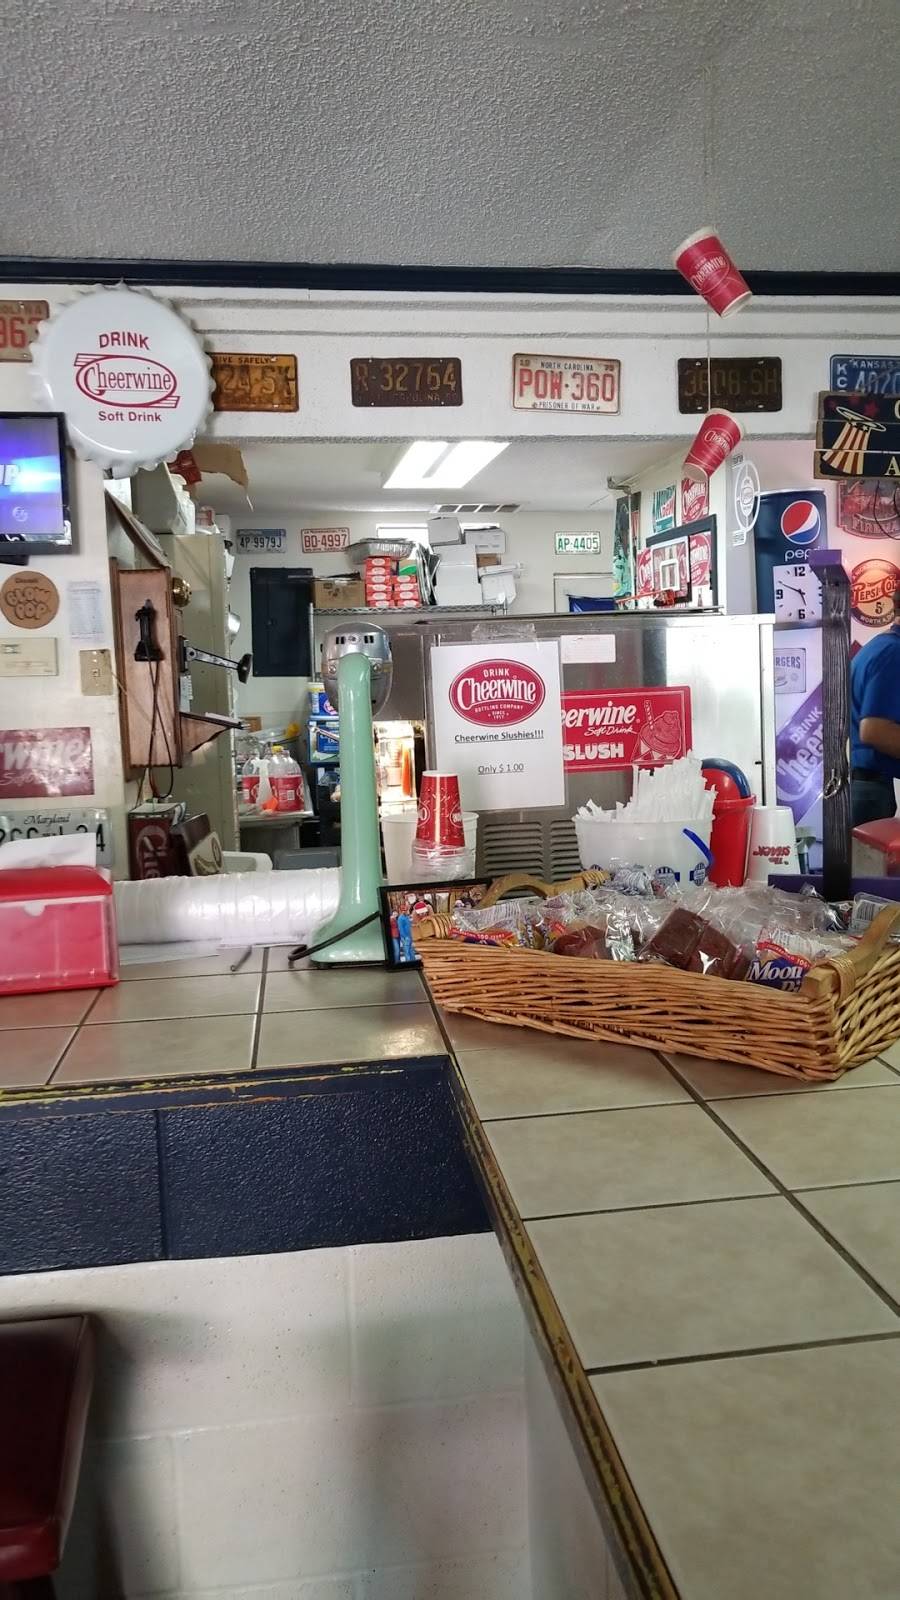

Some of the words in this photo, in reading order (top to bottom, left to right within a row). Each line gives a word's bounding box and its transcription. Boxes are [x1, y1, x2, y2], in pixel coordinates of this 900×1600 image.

[99, 331, 149, 350] DRINK
[541, 361, 561, 369] NORTH
[564, 363, 593, 371] CAROLINA
[84, 363, 171, 395] Cheerwine
[540, 401, 568, 409] PRISONER
[98, 411, 125, 421] Soft
[128, 411, 162, 422] Drink
[794, 566, 806, 577] 12
[776, 589, 784, 600] 9
[798, 609, 806, 619] 6
[482, 668, 510, 678] DRINK
[457, 677, 537, 711] Cheerwine
[584, 728, 606, 737] Soft
[606, 725, 638, 736] Drink
[789, 706, 823, 745] DRINK
[455, 734, 499, 742] Cheerwine
[501, 730, 544, 740] Slushies!!!
[563, 742, 625, 760] SLUSH
[478, 765, 497, 775] Only
[507, 763, 524, 772] 1.00
[24, 814, 71, 827] Maryland
[749, 961, 803, 980] Moon
